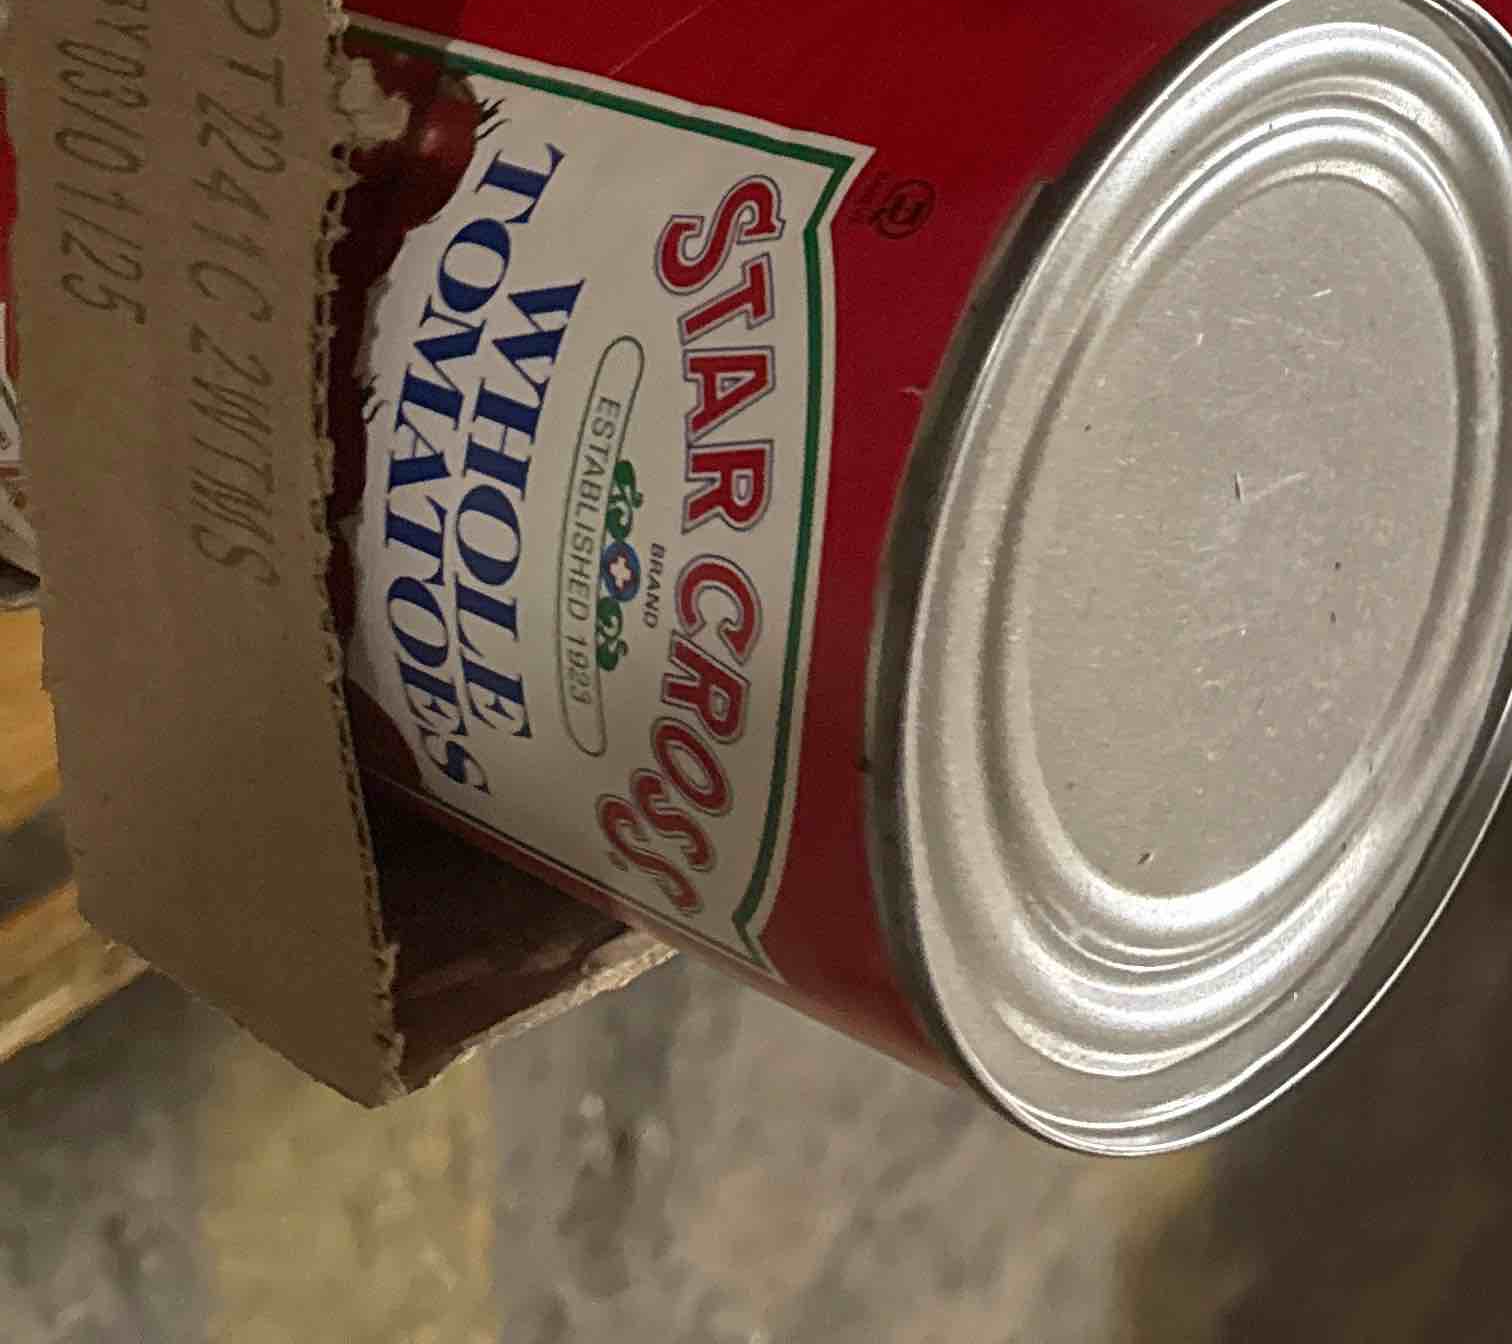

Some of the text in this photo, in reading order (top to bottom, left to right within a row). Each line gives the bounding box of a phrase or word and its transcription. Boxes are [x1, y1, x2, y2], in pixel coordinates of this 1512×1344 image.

[52, 39, 150, 326] 03/01/25
[382, 142, 565, 796] TOMATOES
[452, 278, 584, 738] WHOLE
[564, 396, 622, 706] ESTABLISHED 1923
[595, 175, 786, 914] STAR CROSS
[641, 543, 667, 630] BRAND
